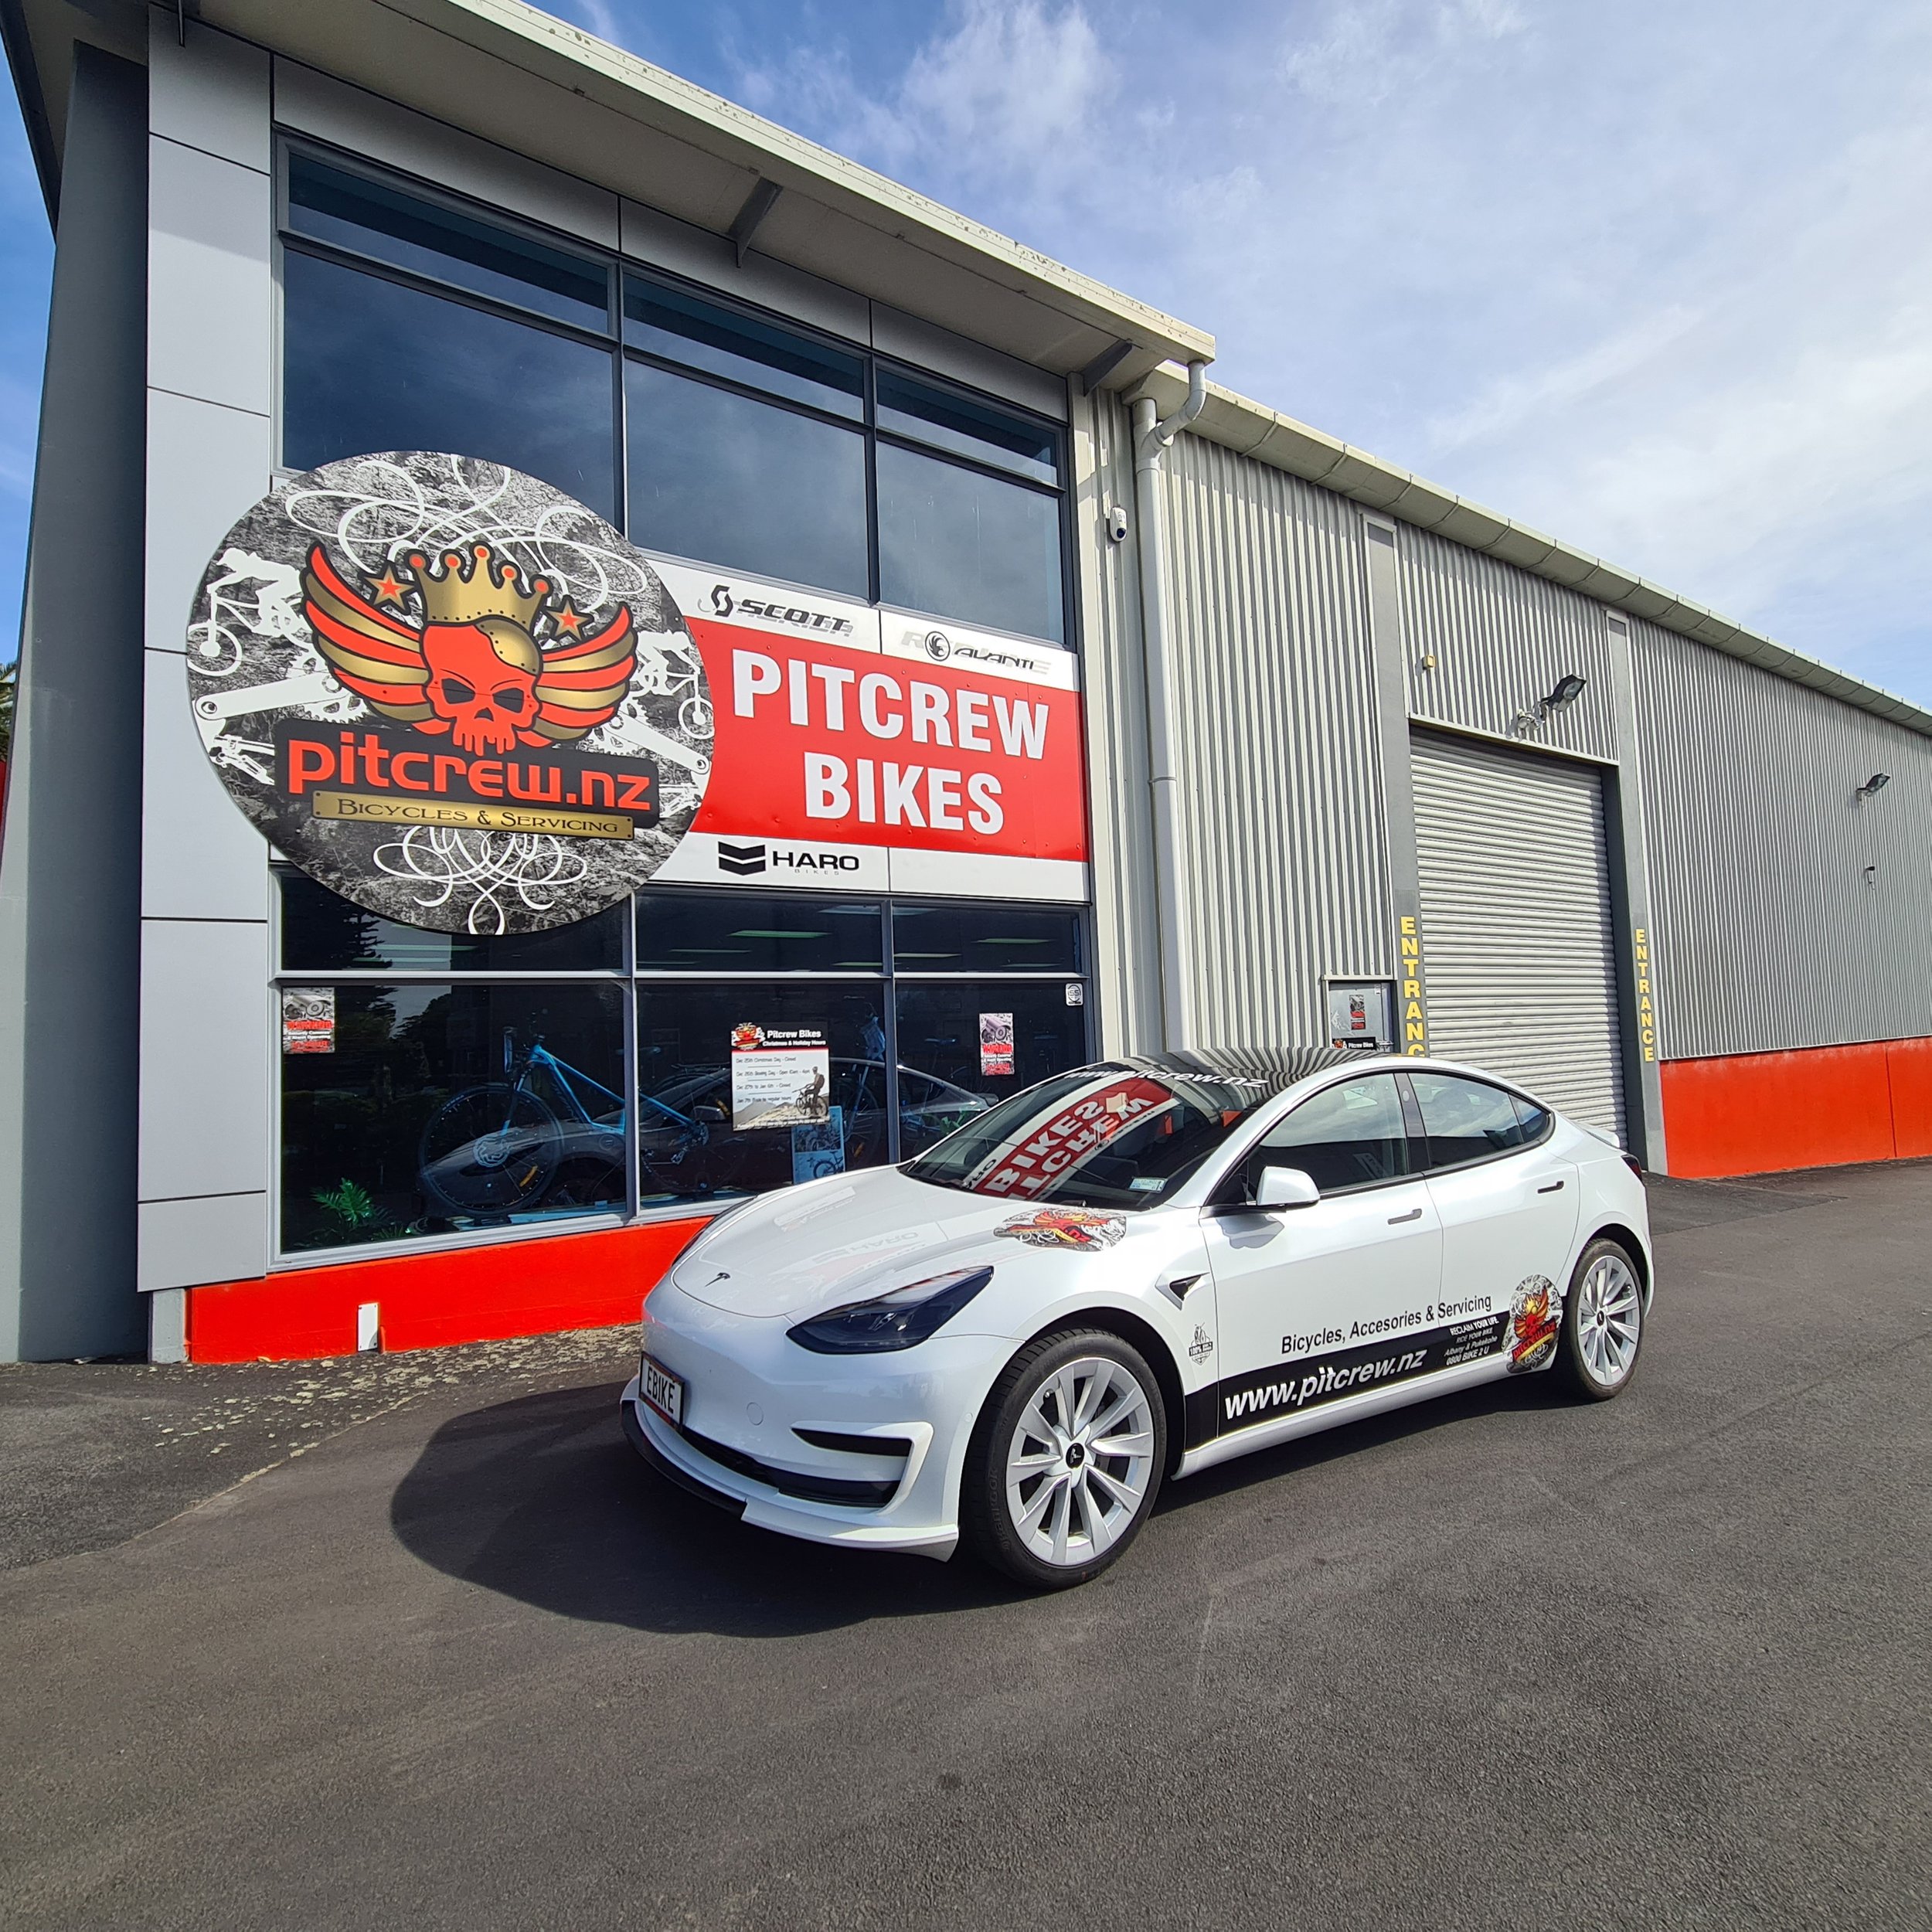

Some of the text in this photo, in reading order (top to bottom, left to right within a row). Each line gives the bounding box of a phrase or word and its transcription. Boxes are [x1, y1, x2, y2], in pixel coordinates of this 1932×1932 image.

[738, 599, 850, 631] SCOTT
[954, 648, 1034, 669] AVANTI
[732, 648, 1049, 760] PITCREW
[287, 731, 650, 810] pitcrew.nz
[804, 752, 1004, 835] BIKES
[478, 810, 492, 826] &
[773, 851, 859, 871] HARO
[1400, 917, 1427, 1057] ENTRANC
[1635, 929, 1655, 1063] ENTRANCE
[767, 1029, 821, 1039] Pitcrew Bikes
[1063, 1069, 1269, 1088] www.pitcrew.nz
[1281, 1295, 1492, 1354] Bicycles, Accesories & Servicing
[1450, 1323, 1475, 1335] RECLAIM
[1473, 1318, 1489, 1329] YOUR
[1462, 1349, 1478, 1361] BIKE
[1478, 1347, 1484, 1356] 2
[1484, 1345, 1490, 1355] U
[646, 1365, 675, 1415] EBIKE
[1224, 1349, 1428, 1420] www.pitcrew.nz
